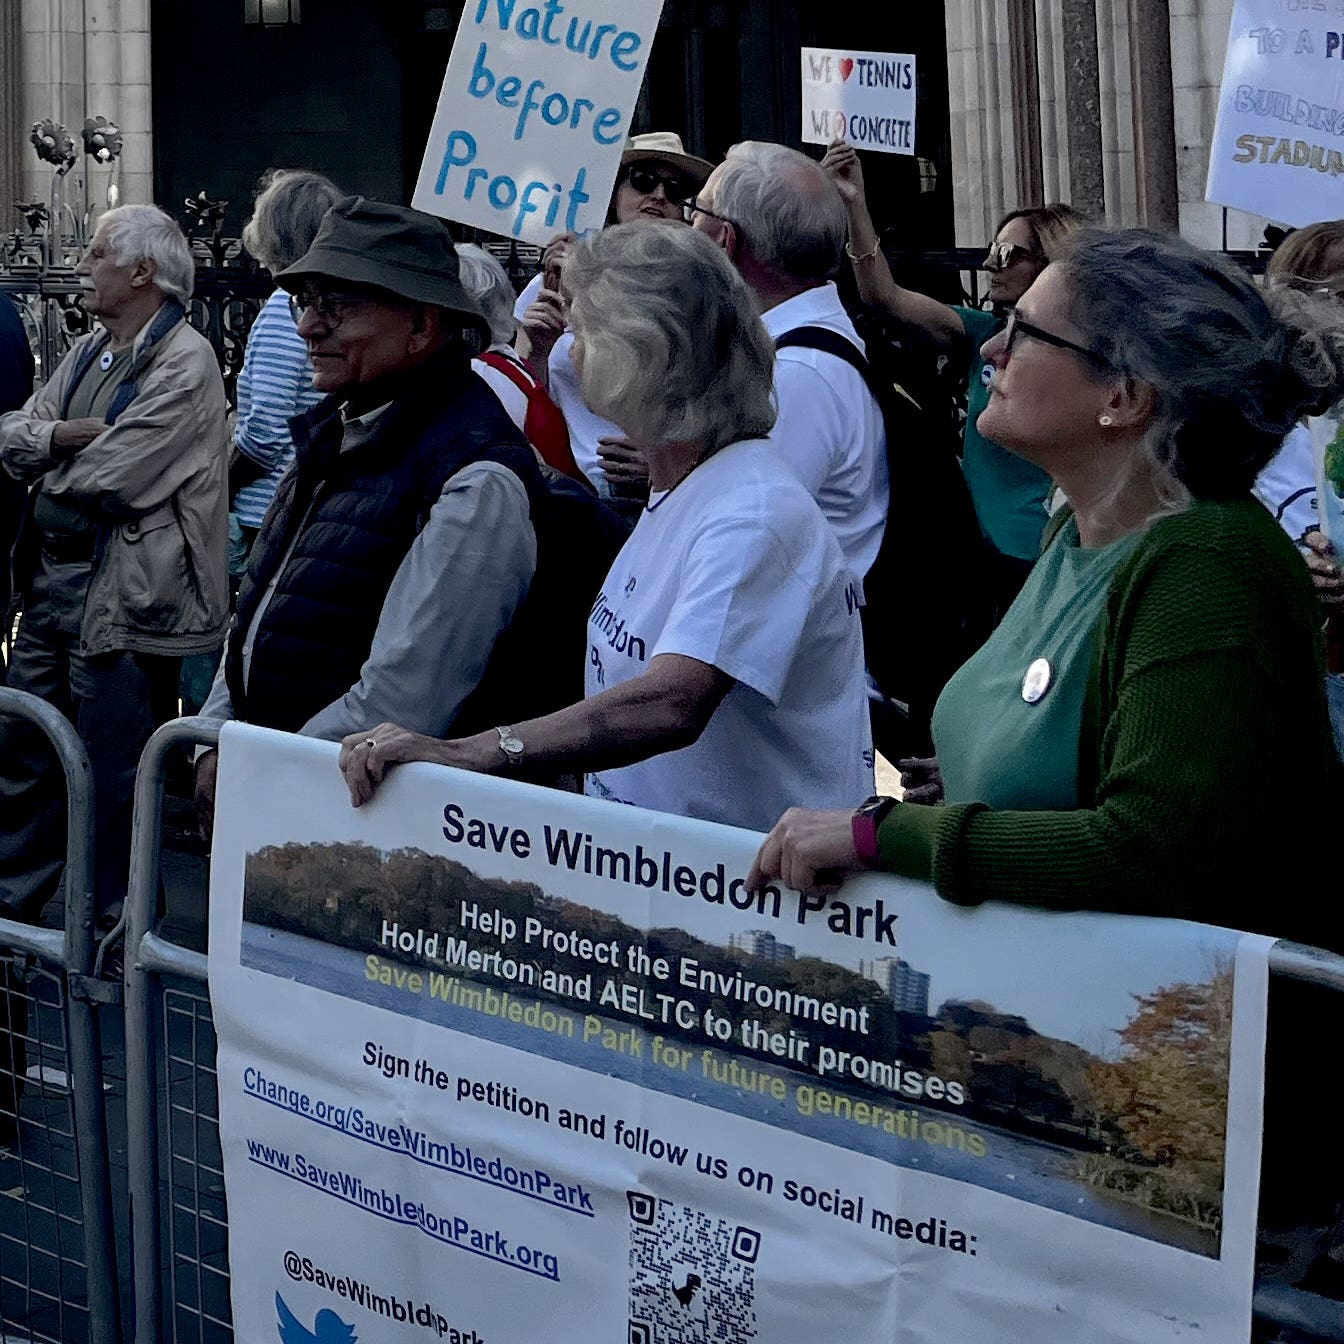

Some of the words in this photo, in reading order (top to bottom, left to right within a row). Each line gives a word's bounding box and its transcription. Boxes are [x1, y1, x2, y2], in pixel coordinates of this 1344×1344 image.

[467, 41, 623, 145] before
[809, 54, 833, 84] WE
[857, 58, 913, 89] TENNIS
[811, 109, 830, 138] WE
[849, 115, 911, 148] CONCRETE
[434, 129, 590, 240] Profit
[442, 803, 531, 859] Save
[543, 824, 782, 918] Wimbledon
[797, 890, 899, 947] Park
[381, 919, 439, 958] Hold
[445, 936, 535, 986] Merton
[542, 967, 592, 1002] and
[599, 979, 696, 1030] AELTC
[704, 1008, 733, 1041] to
[741, 1017, 810, 1062] their
[818, 1045, 965, 1106] promises
[461, 900, 516, 945] Help
[524, 916, 620, 968] Protect
[627, 944, 670, 980] the
[679, 956, 871, 1035] Environment
[364, 954, 423, 994] Save
[429, 971, 575, 1039] Wimbledon
[583, 1014, 643, 1059] Park
[652, 1035, 693, 1072] for
[701, 1049, 788, 1100] future
[797, 1084, 987, 1157] generations
[244, 1067, 594, 1213] Change.org/SaveWimbledonPark
[247, 1139, 561, 1280] www.SaveWimbledonPark.org
[362, 1041, 410, 1079] Sign
[414, 1058, 449, 1090] the
[457, 1076, 550, 1123] petition
[558, 1107, 605, 1140] and
[614, 1118, 689, 1168] follow
[696, 1151, 728, 1183] us
[737, 1164, 773, 1193] on
[782, 1169, 863, 1223] social
[871, 1206, 979, 1256] media:
